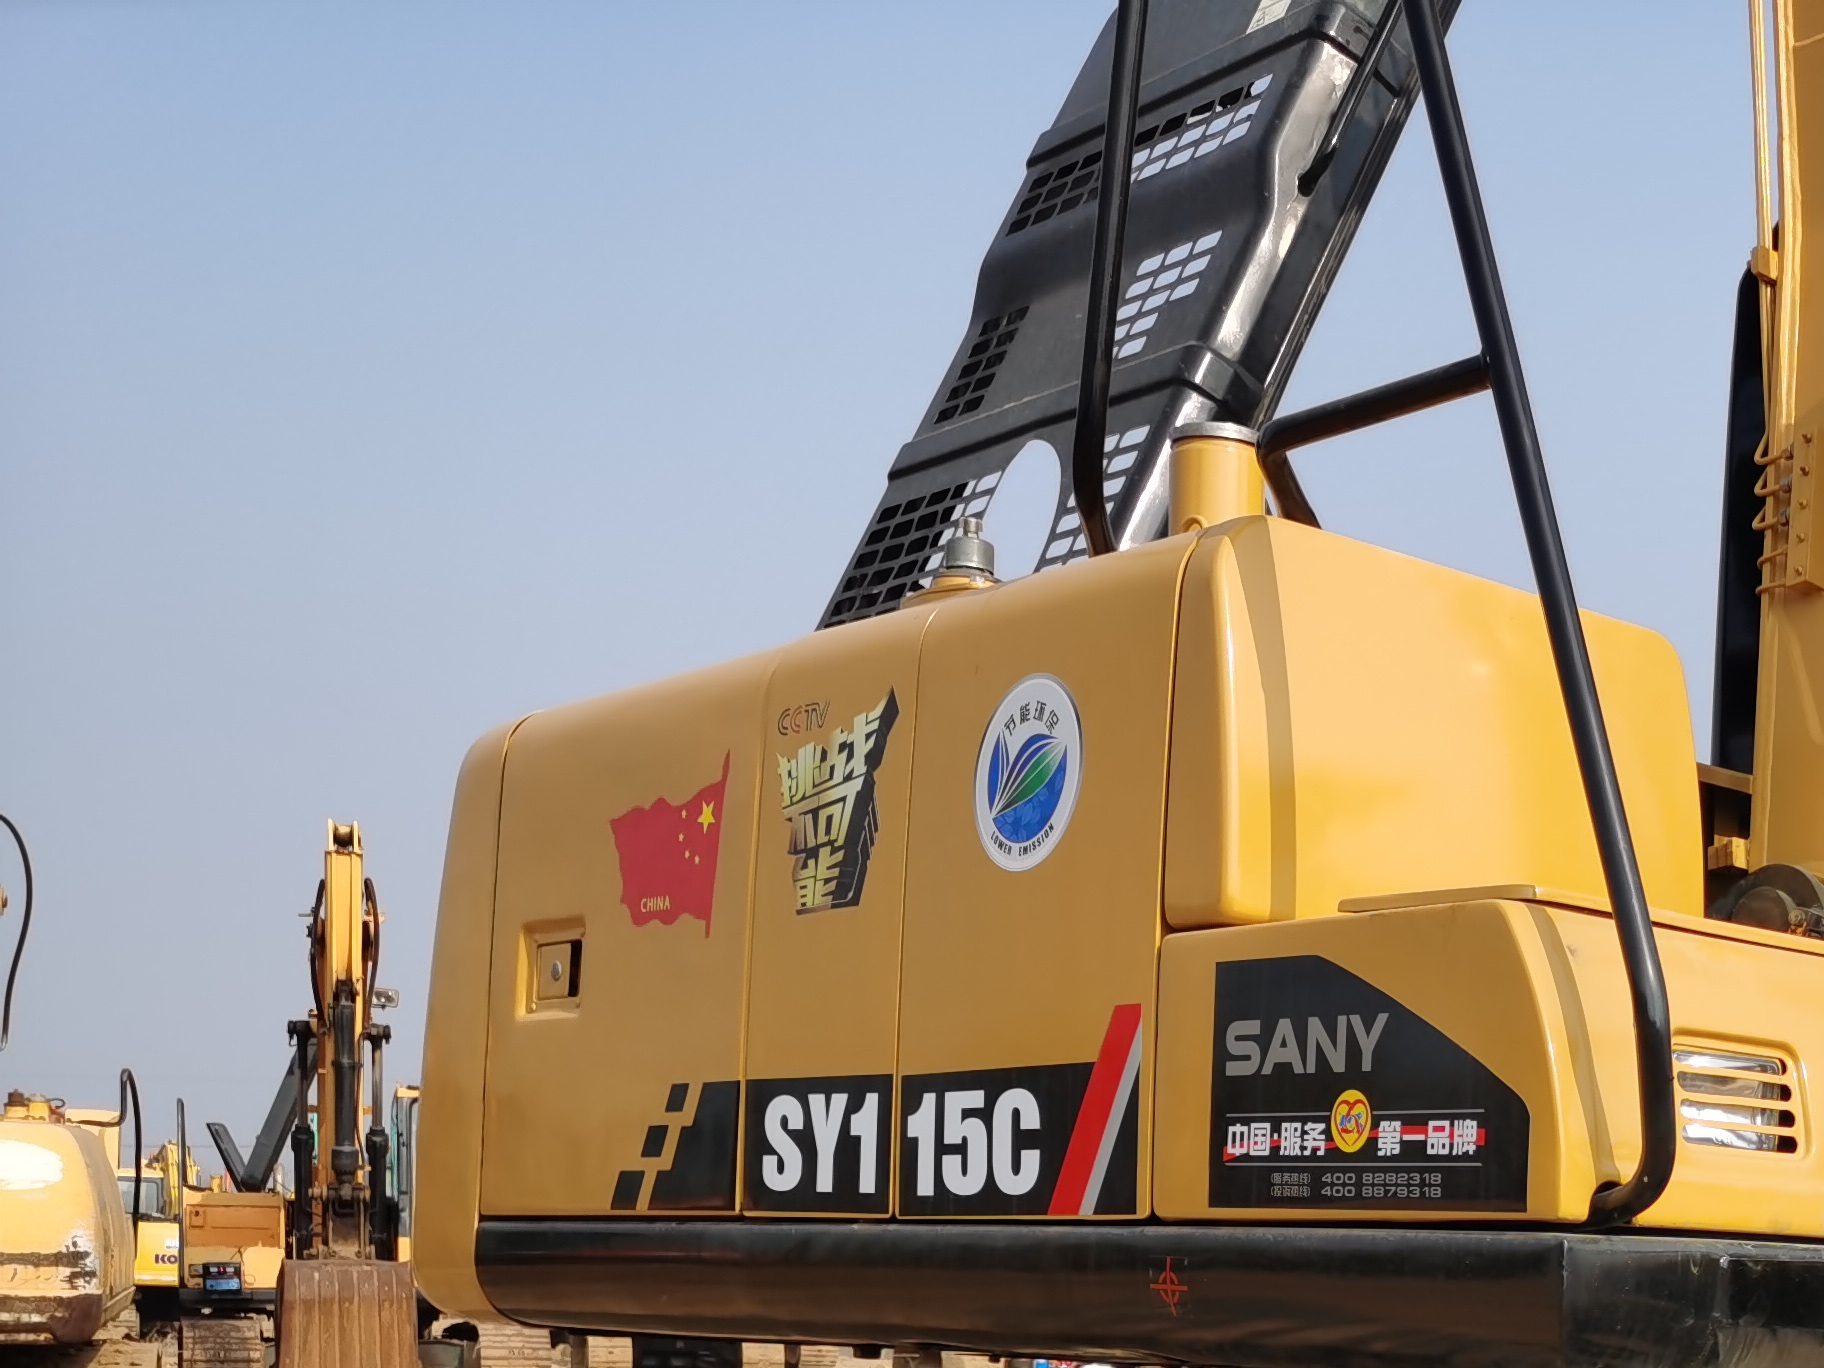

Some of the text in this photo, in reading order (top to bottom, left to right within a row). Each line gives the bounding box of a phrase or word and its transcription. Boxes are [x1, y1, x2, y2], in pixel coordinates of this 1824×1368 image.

[777, 700, 831, 736] CCTV
[1003, 700, 1060, 736] 节能环保
[990, 822, 1055, 857] LOWER EMISSION
[640, 895, 671, 913] CHINA
[1225, 1012, 1389, 1077] SANY
[1377, 1119, 1479, 1157] 第一品牌
[1321, 1172, 1356, 1184] 400
[1362, 1172, 1442, 1185] 8282318
[1321, 1186, 1356, 1197] 400
[1361, 1186, 1442, 1198] 8879318
